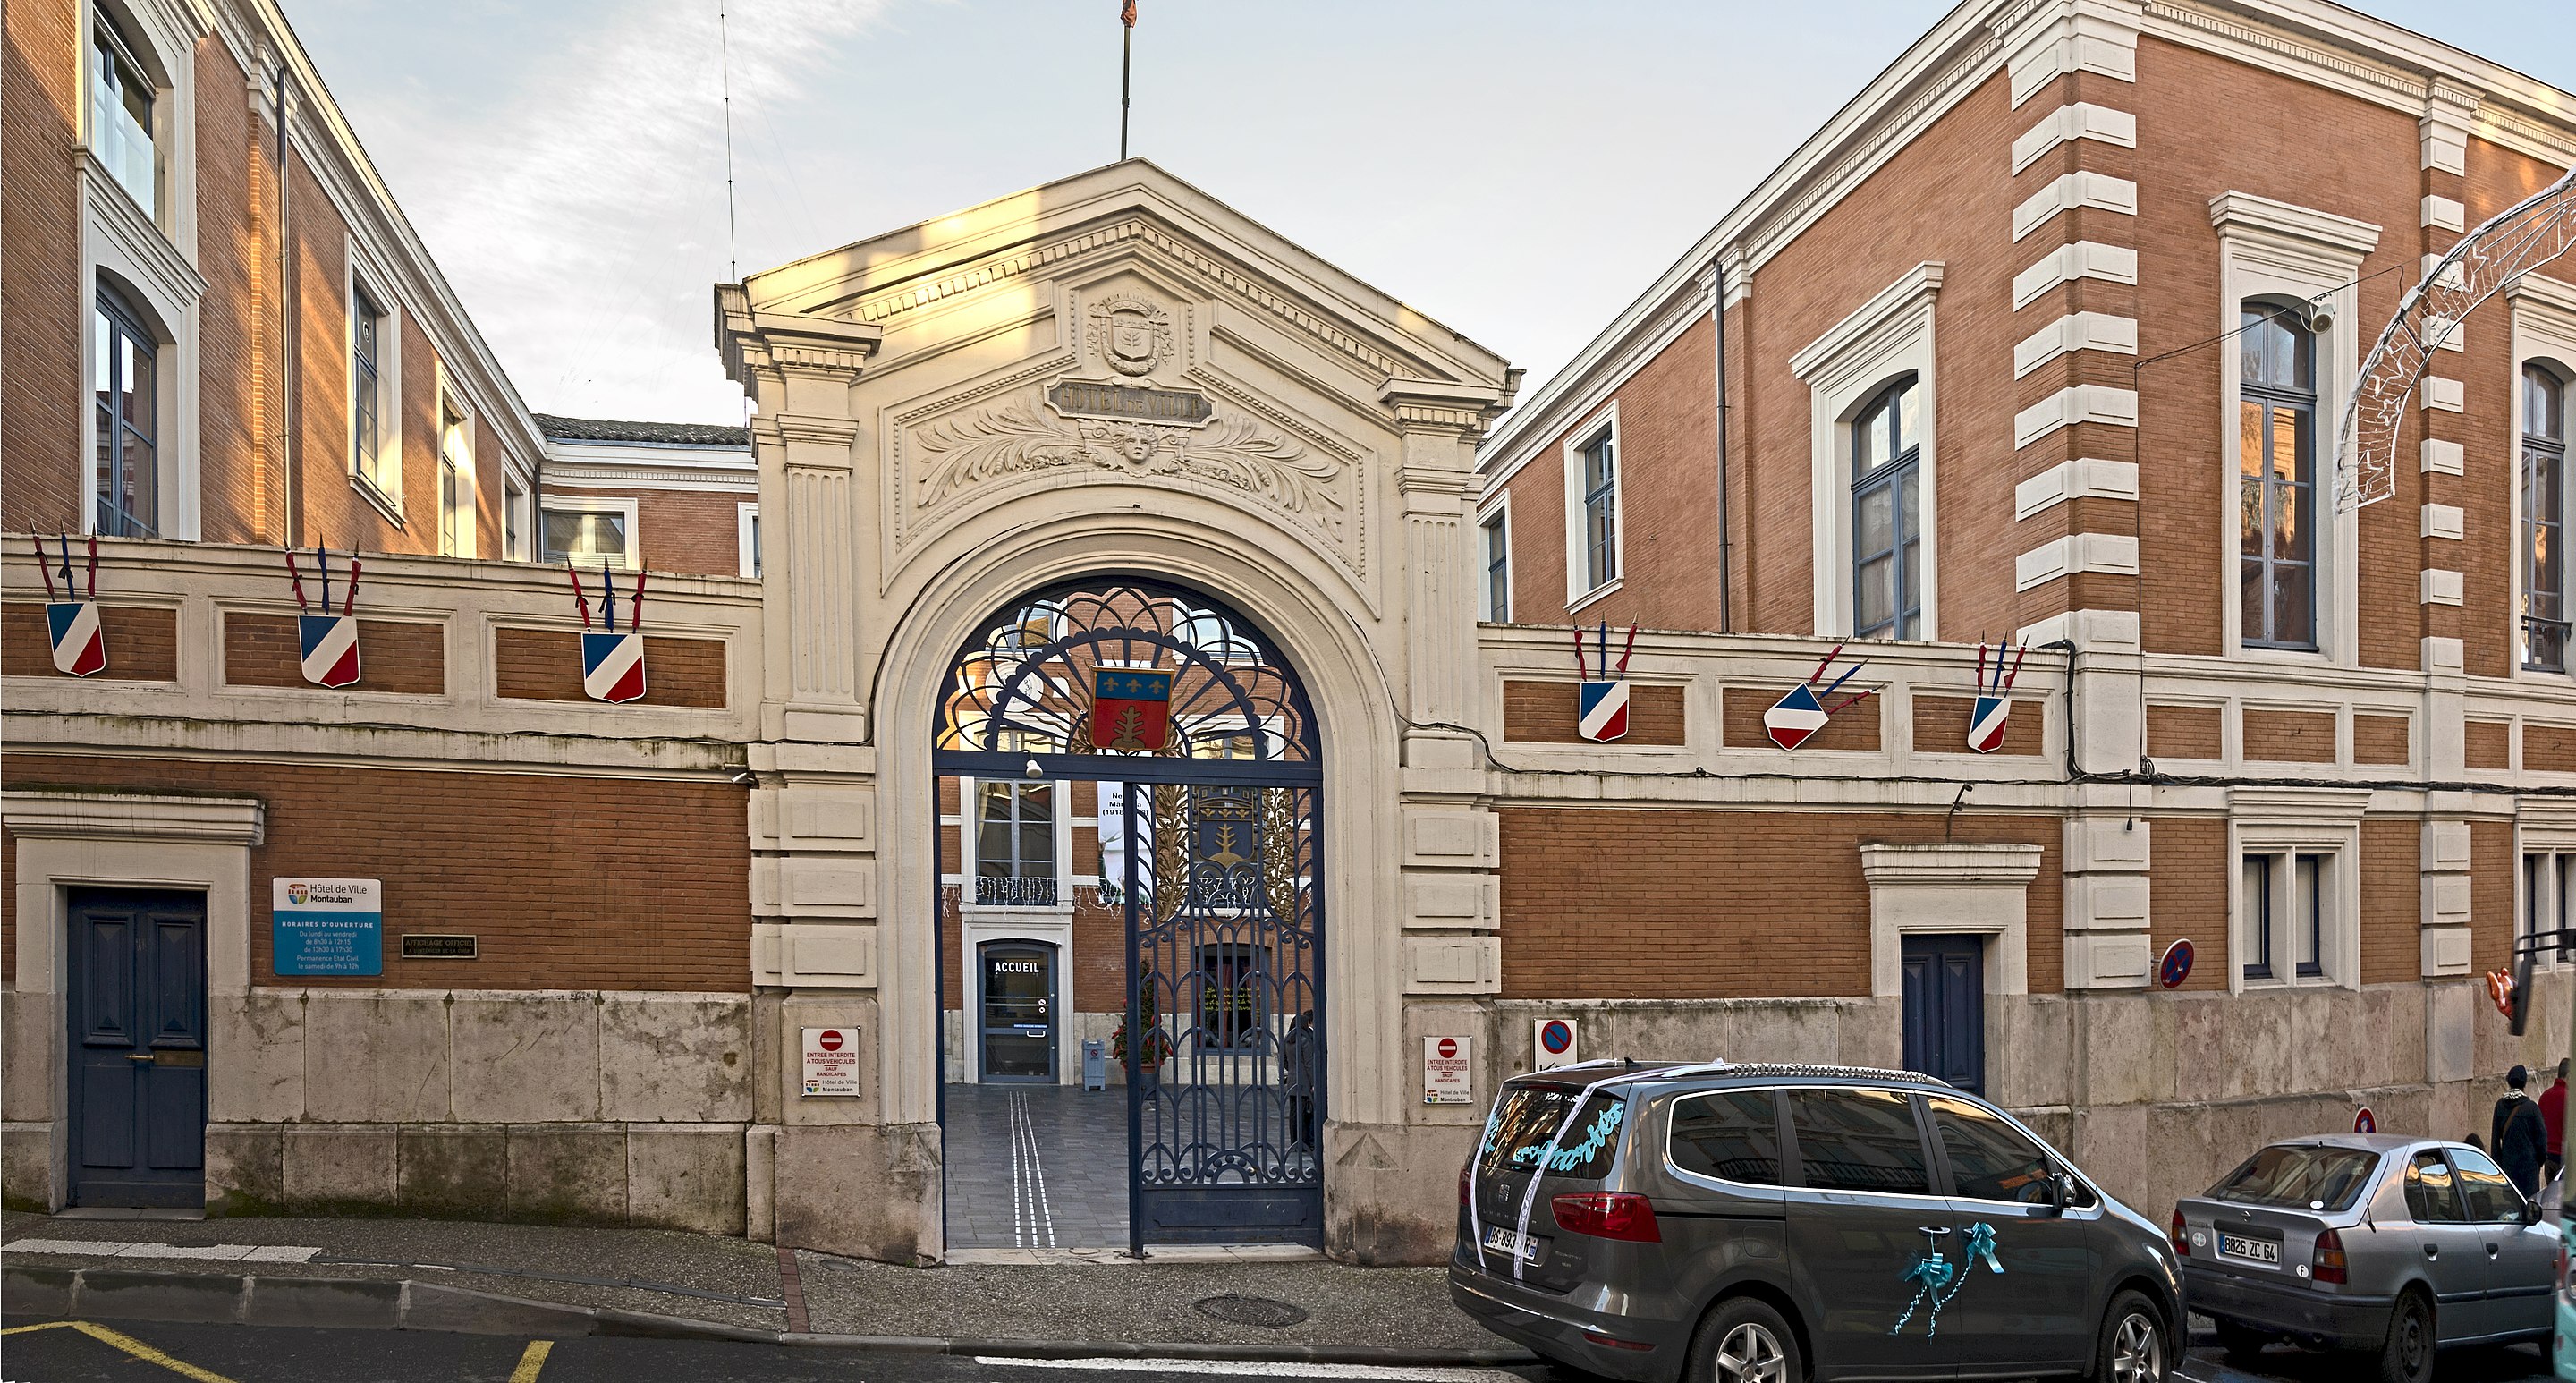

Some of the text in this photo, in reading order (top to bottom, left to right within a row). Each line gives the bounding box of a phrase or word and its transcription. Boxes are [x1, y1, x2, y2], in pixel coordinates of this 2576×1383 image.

[1127, 400, 1144, 413] DE
[1146, 394, 1201, 418] VILLE
[310, 884, 367, 894] Hôtel de Ville
[310, 895, 352, 904] Montauban
[995, 962, 1039, 973] ACCUEIL
[1489, 1227, 1531, 1254] BS-893R
[2224, 1237, 2275, 1260] 8826 ZC 64
